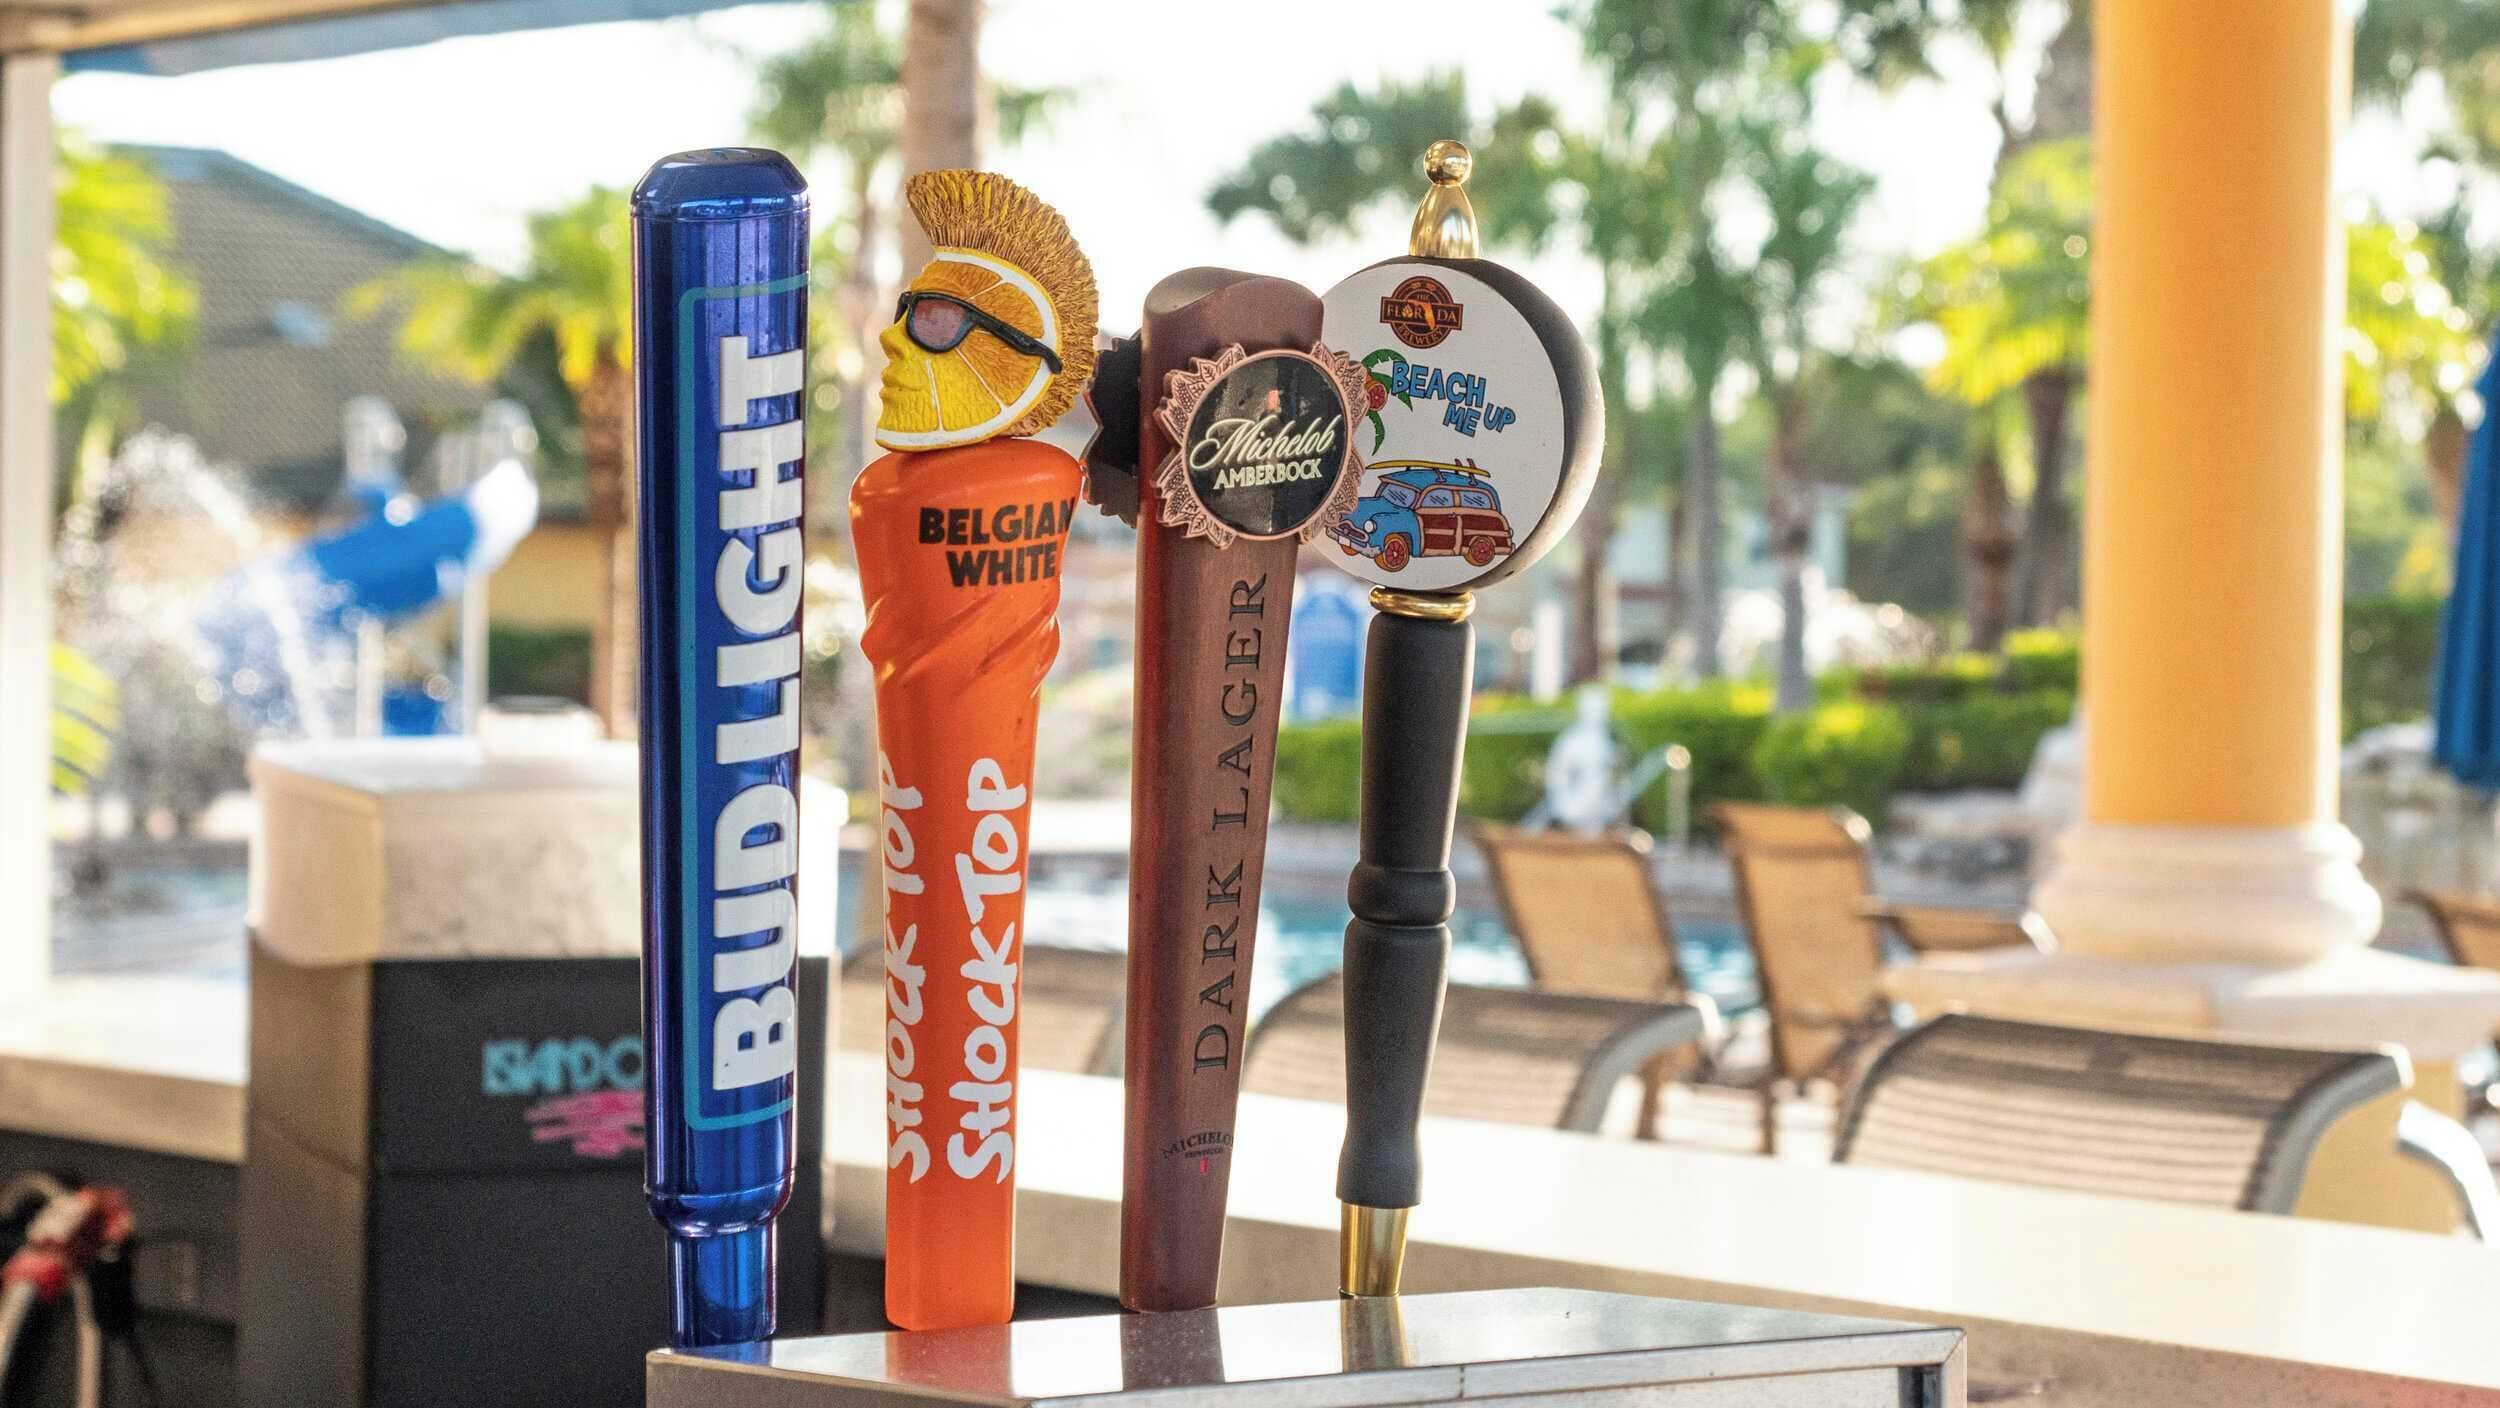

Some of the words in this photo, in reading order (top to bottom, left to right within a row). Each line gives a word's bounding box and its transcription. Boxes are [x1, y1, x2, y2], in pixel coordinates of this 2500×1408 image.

[1391, 360, 1487, 408] BEACH
[1442, 401, 1481, 438] ME
[1483, 401, 1516, 433] UP
[1190, 413, 1342, 469] Michelob
[1212, 458, 1323, 490] AMBERBOCK
[715, 335, 804, 765] LIGHT
[918, 496, 1076, 545] BELGIAN
[946, 541, 1057, 587] WHITE
[1212, 573, 1267, 831] LAGER
[955, 758, 1027, 924] TOP
[713, 784, 801, 1092] BUD
[1193, 860, 1244, 1073] DARK
[947, 922, 1018, 1184] SHOCK
